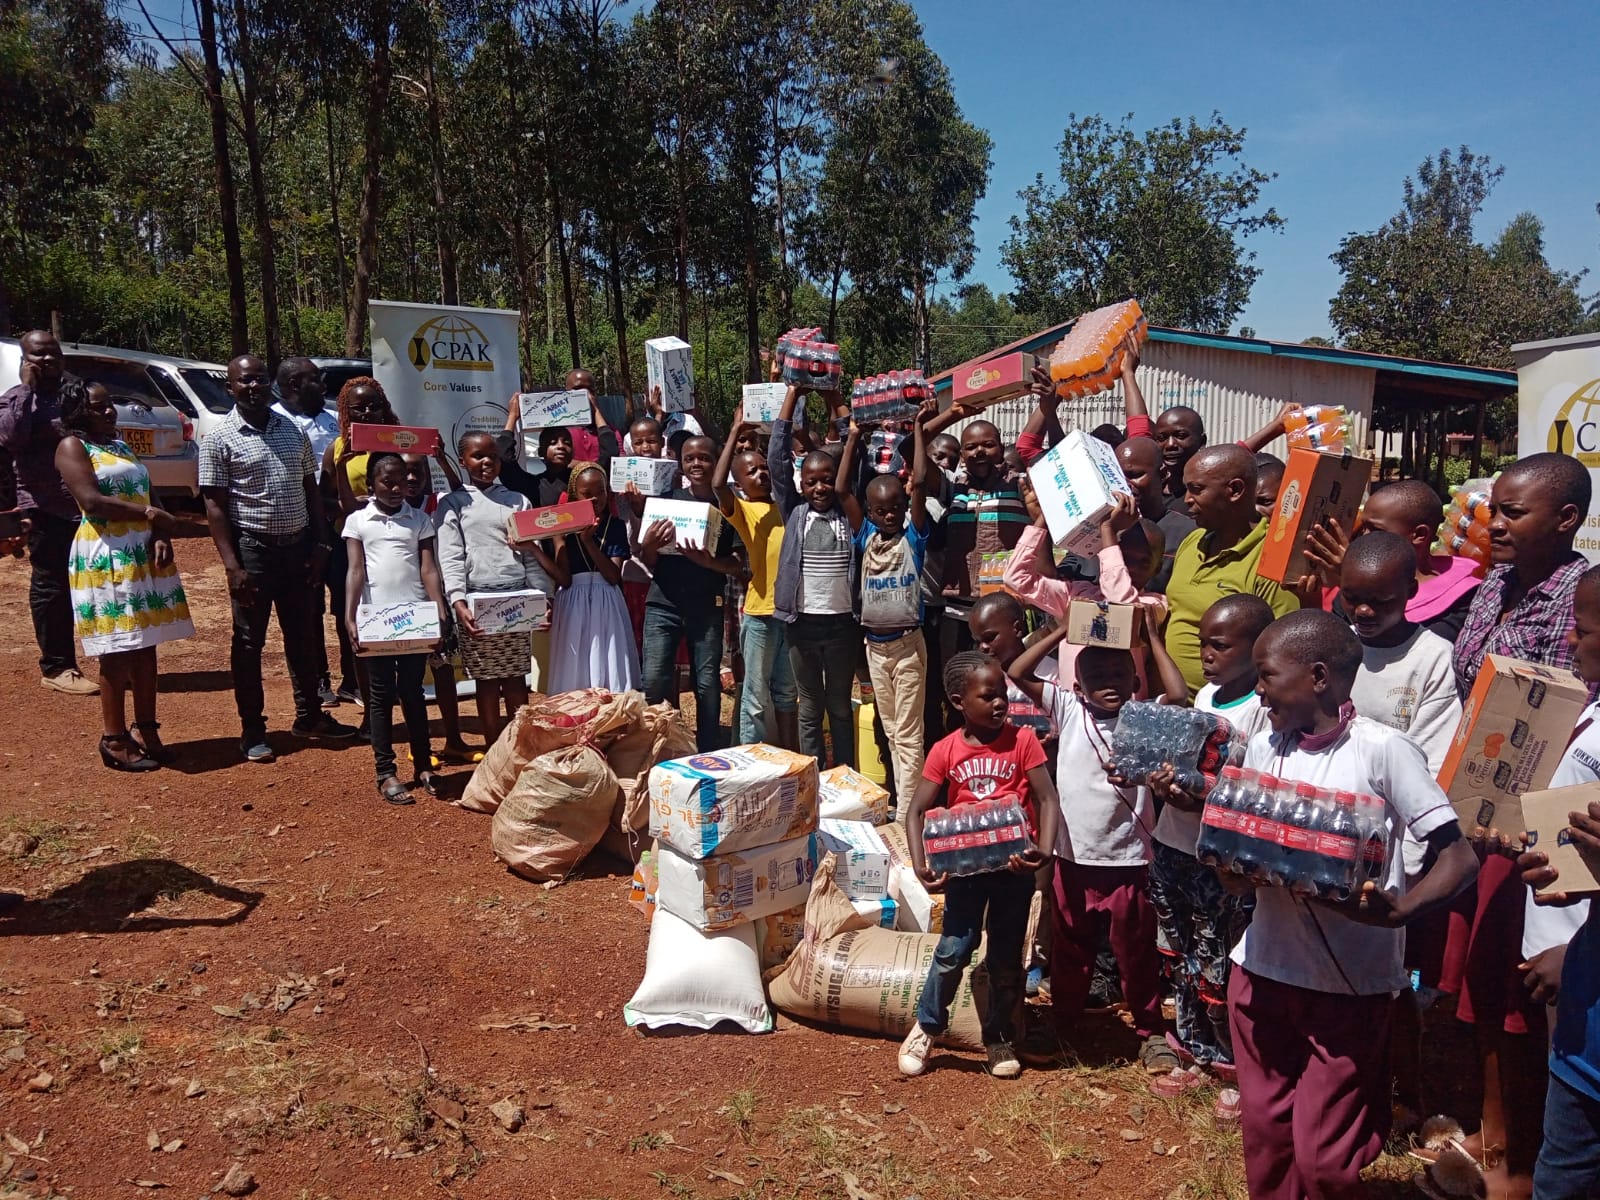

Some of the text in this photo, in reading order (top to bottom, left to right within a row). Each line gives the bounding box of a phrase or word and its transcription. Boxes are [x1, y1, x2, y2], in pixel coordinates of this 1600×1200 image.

[408, 337, 492, 366] ICPAK
[424, 382, 482, 393] Core Values
[126, 431, 145, 441] KCR
[900, 573, 916, 587] UP
[949, 757, 1017, 783] CARDINALS
[924, 944, 933, 953] BY
[813, 964, 825, 986] The
[961, 983, 972, 1008] MADE
